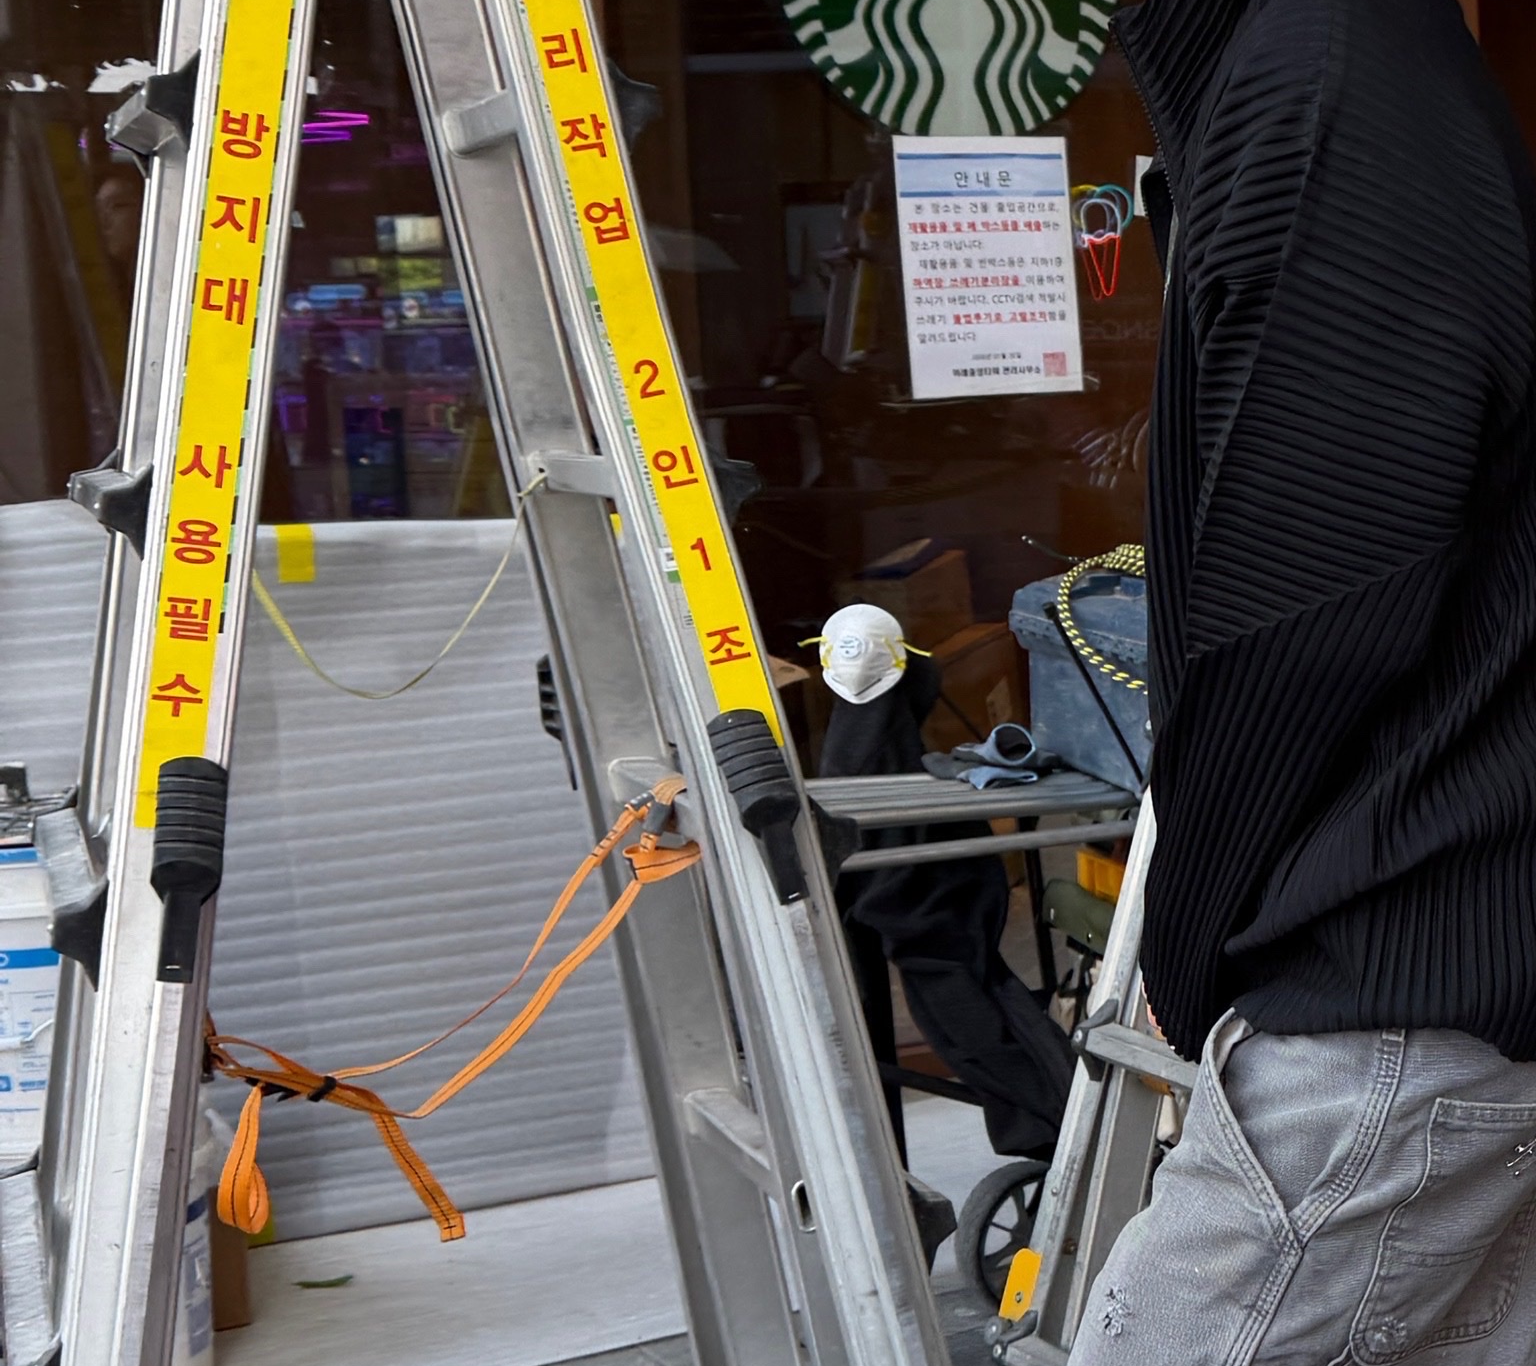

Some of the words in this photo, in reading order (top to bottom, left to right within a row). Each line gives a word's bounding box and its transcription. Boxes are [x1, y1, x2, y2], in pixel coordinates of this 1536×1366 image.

[201, 108, 270, 327] 방지대
[150, 443, 233, 718] 사용필수
[632, 358, 752, 668] 2인1조
